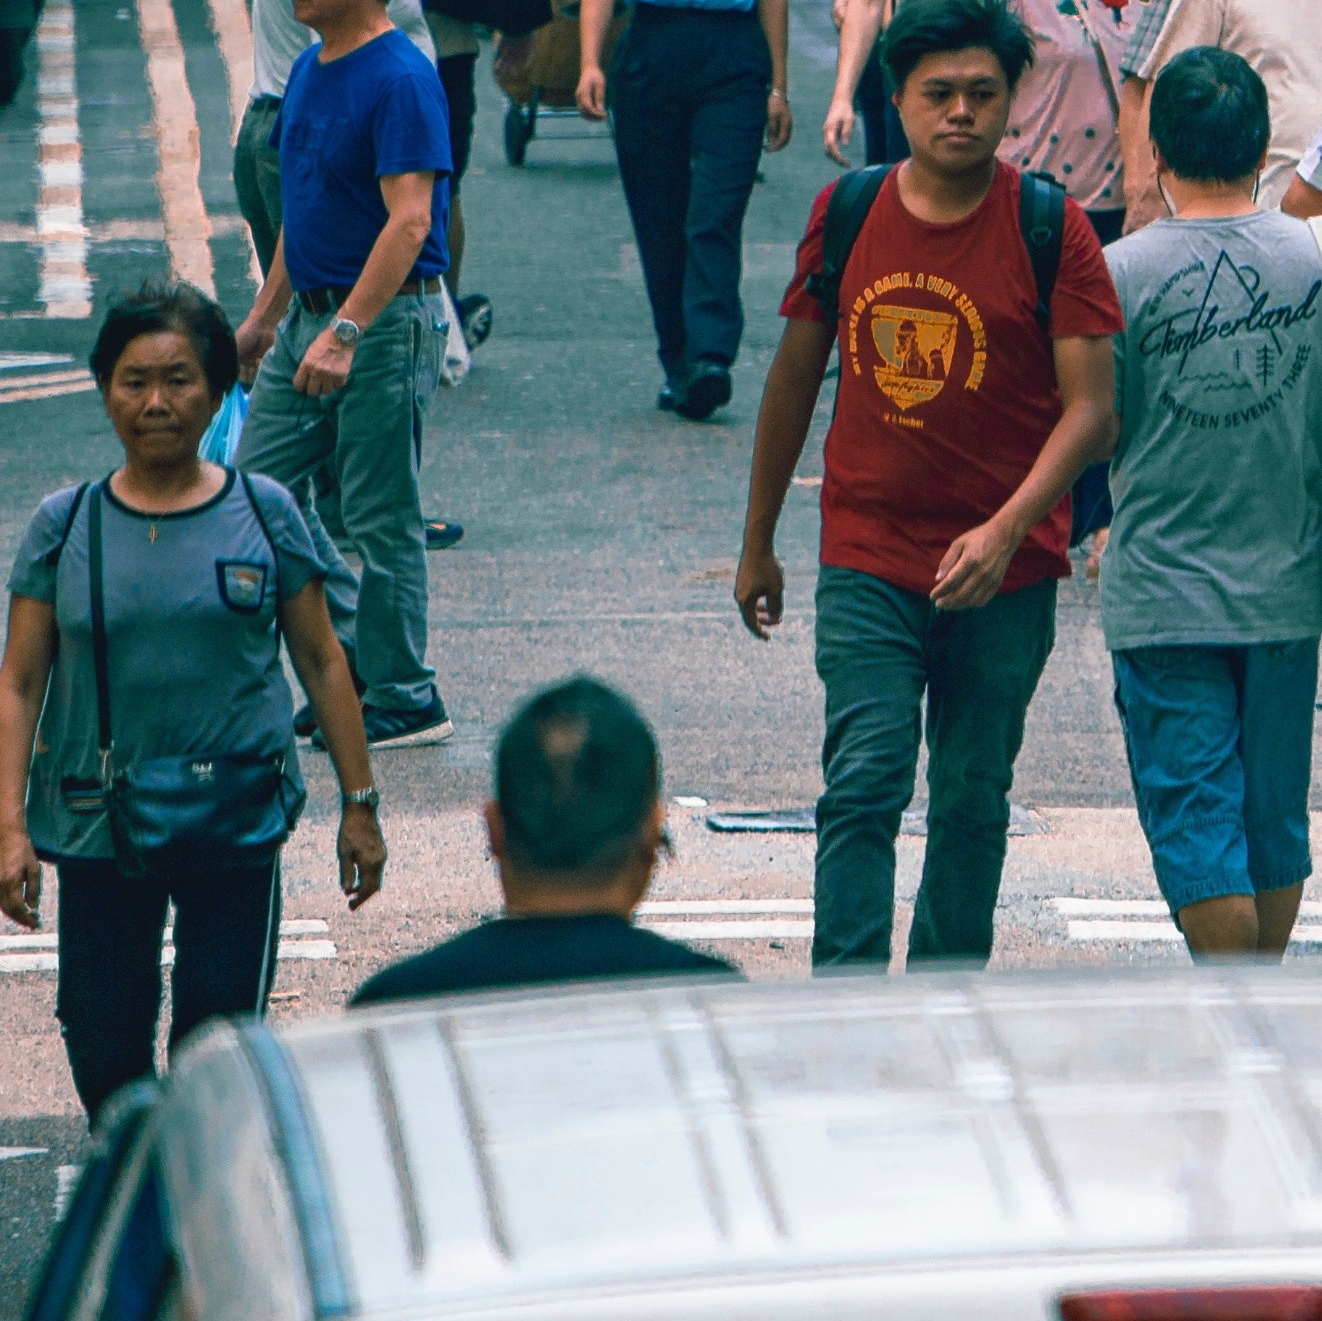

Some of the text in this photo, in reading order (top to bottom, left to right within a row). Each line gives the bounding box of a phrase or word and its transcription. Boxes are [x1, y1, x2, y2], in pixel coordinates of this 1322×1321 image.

[914, 272, 925, 289] A
[926, 274, 960, 302] VERY
[954, 291, 989, 350] SERIOUS
[1139, 279, 1322, 359] Timberland
[1158, 344, 1312, 429] NINETEEN SEVENTY THREE
